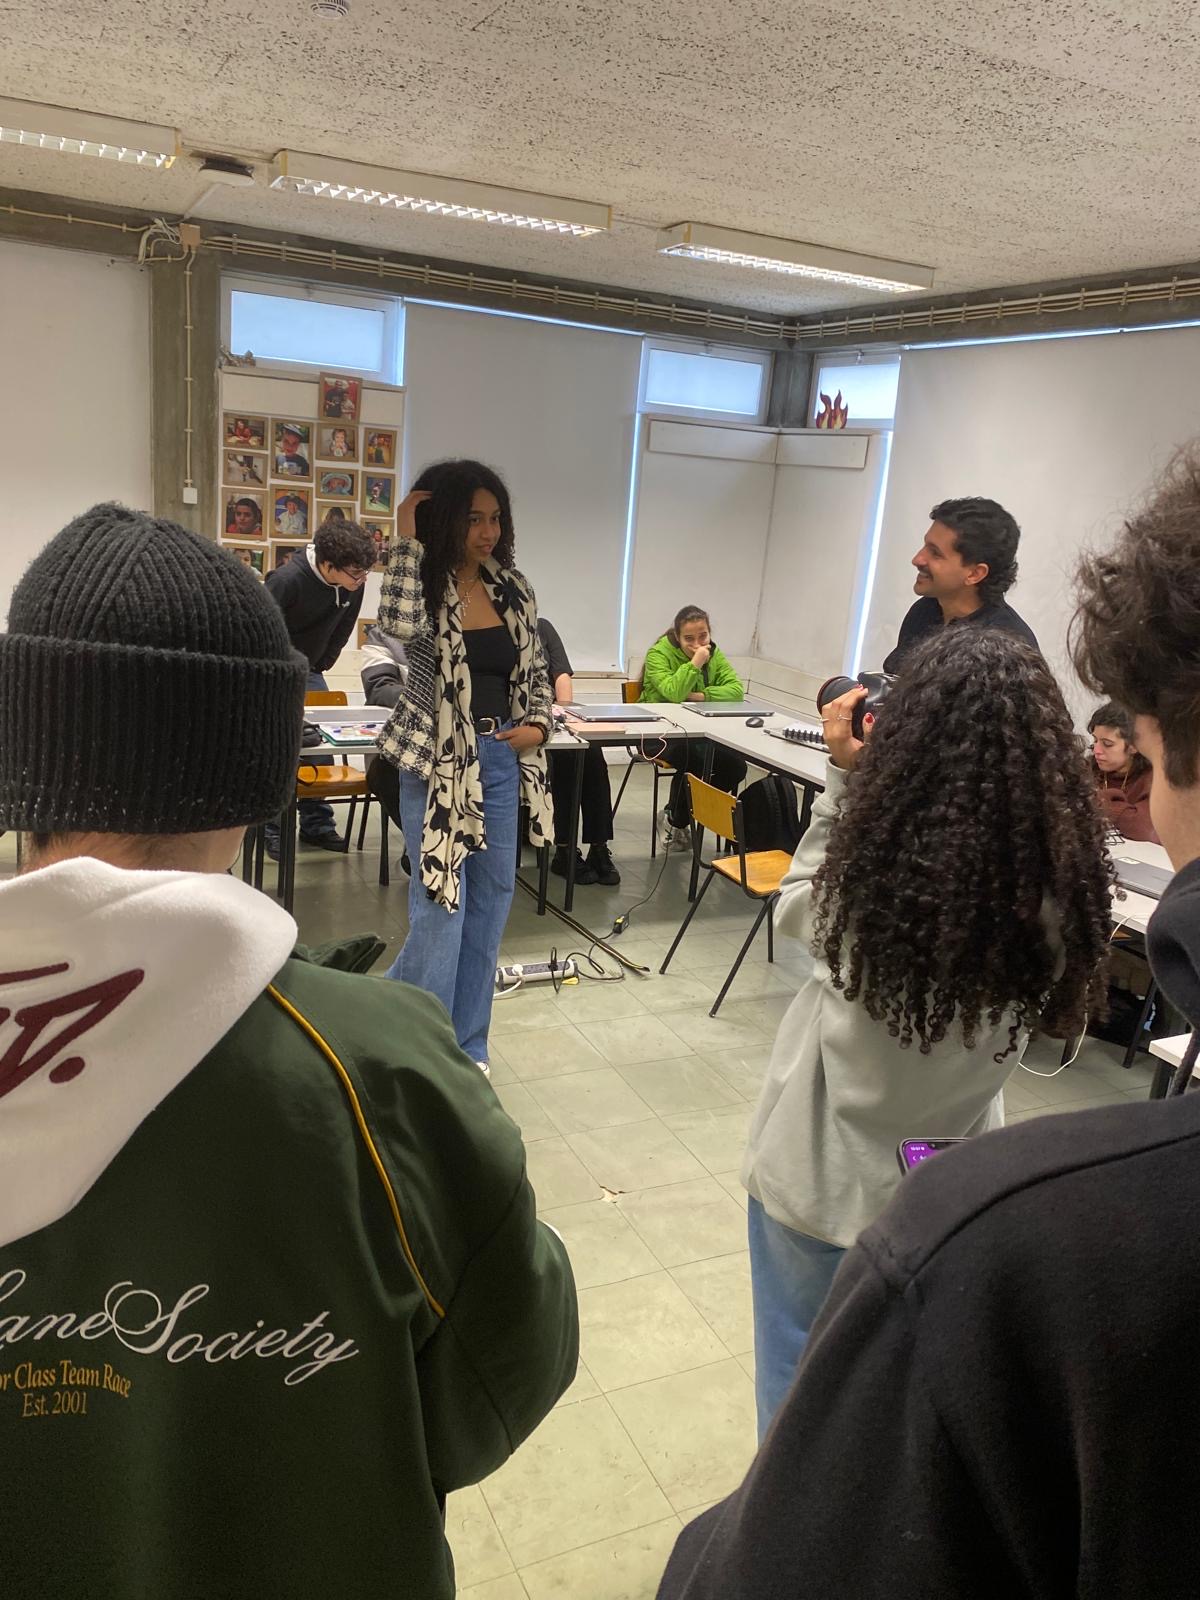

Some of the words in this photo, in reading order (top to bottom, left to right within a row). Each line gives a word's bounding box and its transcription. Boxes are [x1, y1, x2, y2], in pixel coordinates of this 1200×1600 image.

[105, 1281, 359, 1386] Society
[14, 1362, 56, 1389] Class
[60, 1360, 100, 1387] Team
[103, 1363, 132, 1398] Race
[22, 1393, 49, 1417] Est.
[52, 1390, 87, 1415] 2001
